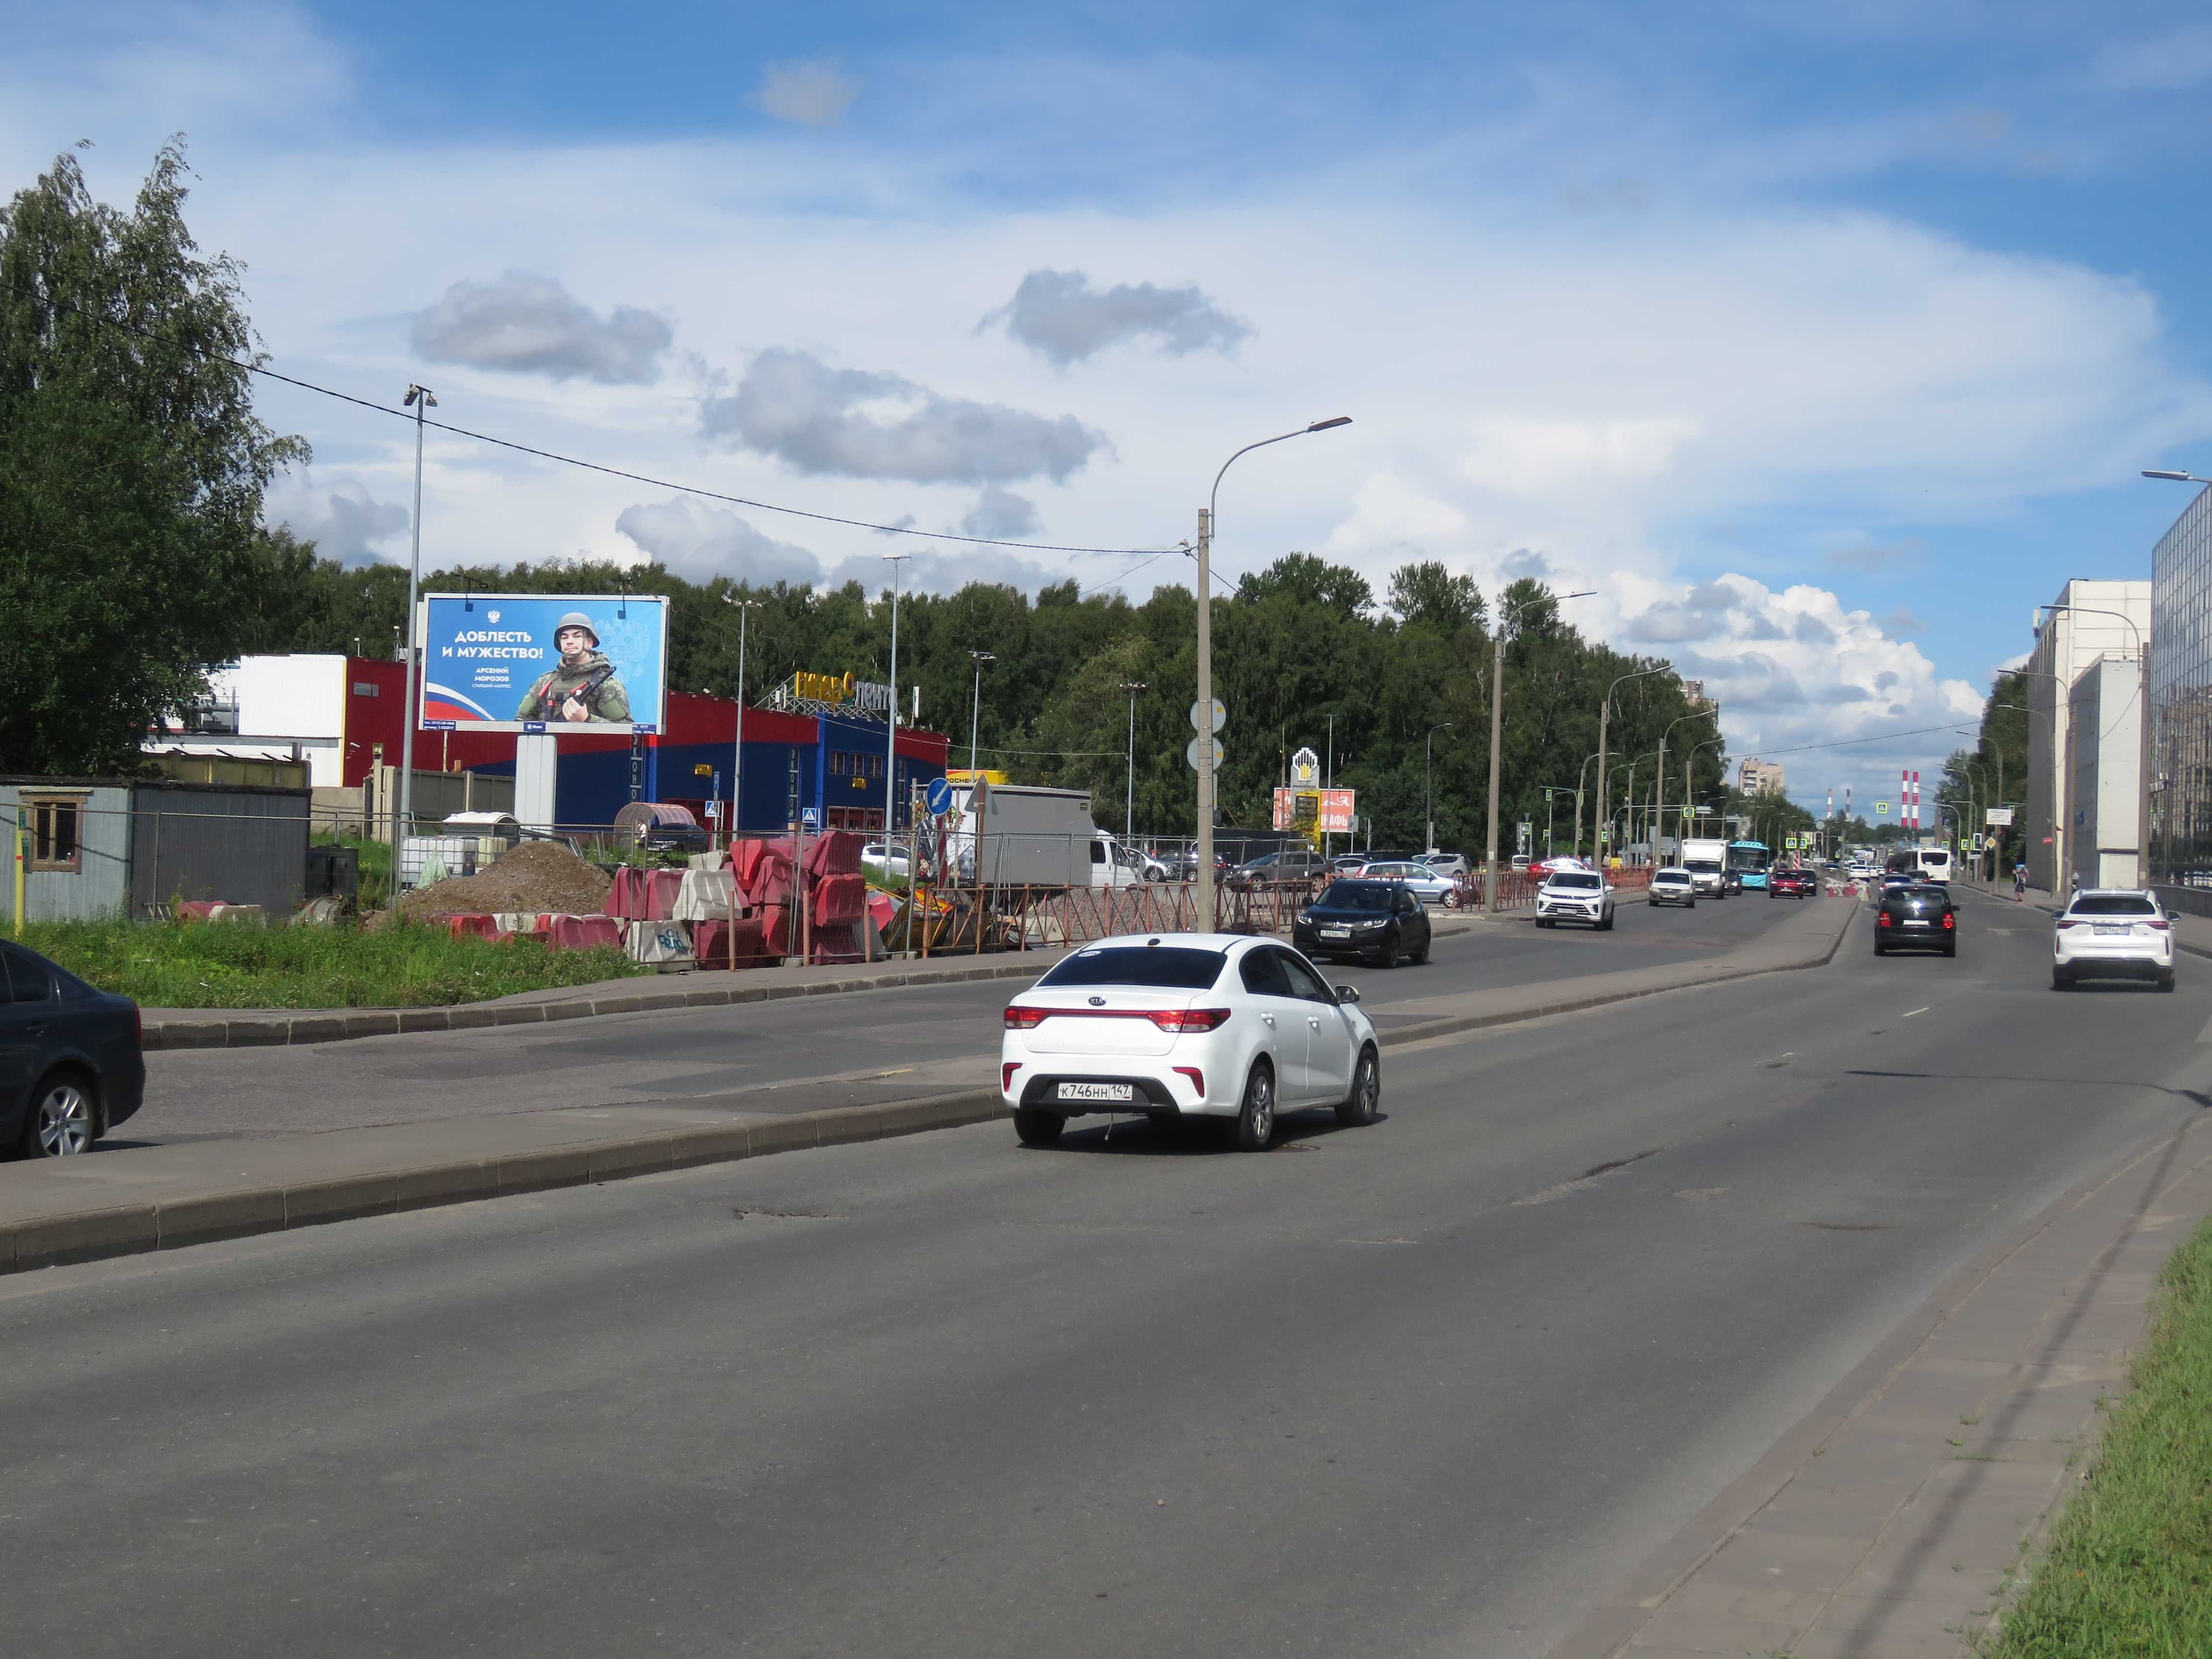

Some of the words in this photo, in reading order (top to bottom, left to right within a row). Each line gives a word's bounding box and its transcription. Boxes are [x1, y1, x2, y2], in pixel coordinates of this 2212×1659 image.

[454, 631, 532, 643] ДОБЛЕСТЬ
[442, 646, 453, 657] И
[457, 647, 544, 659] МУЖЕСТВО!
[1062, 1085, 1107, 1098] К746НН
[1111, 1085, 1129, 1095] 147
